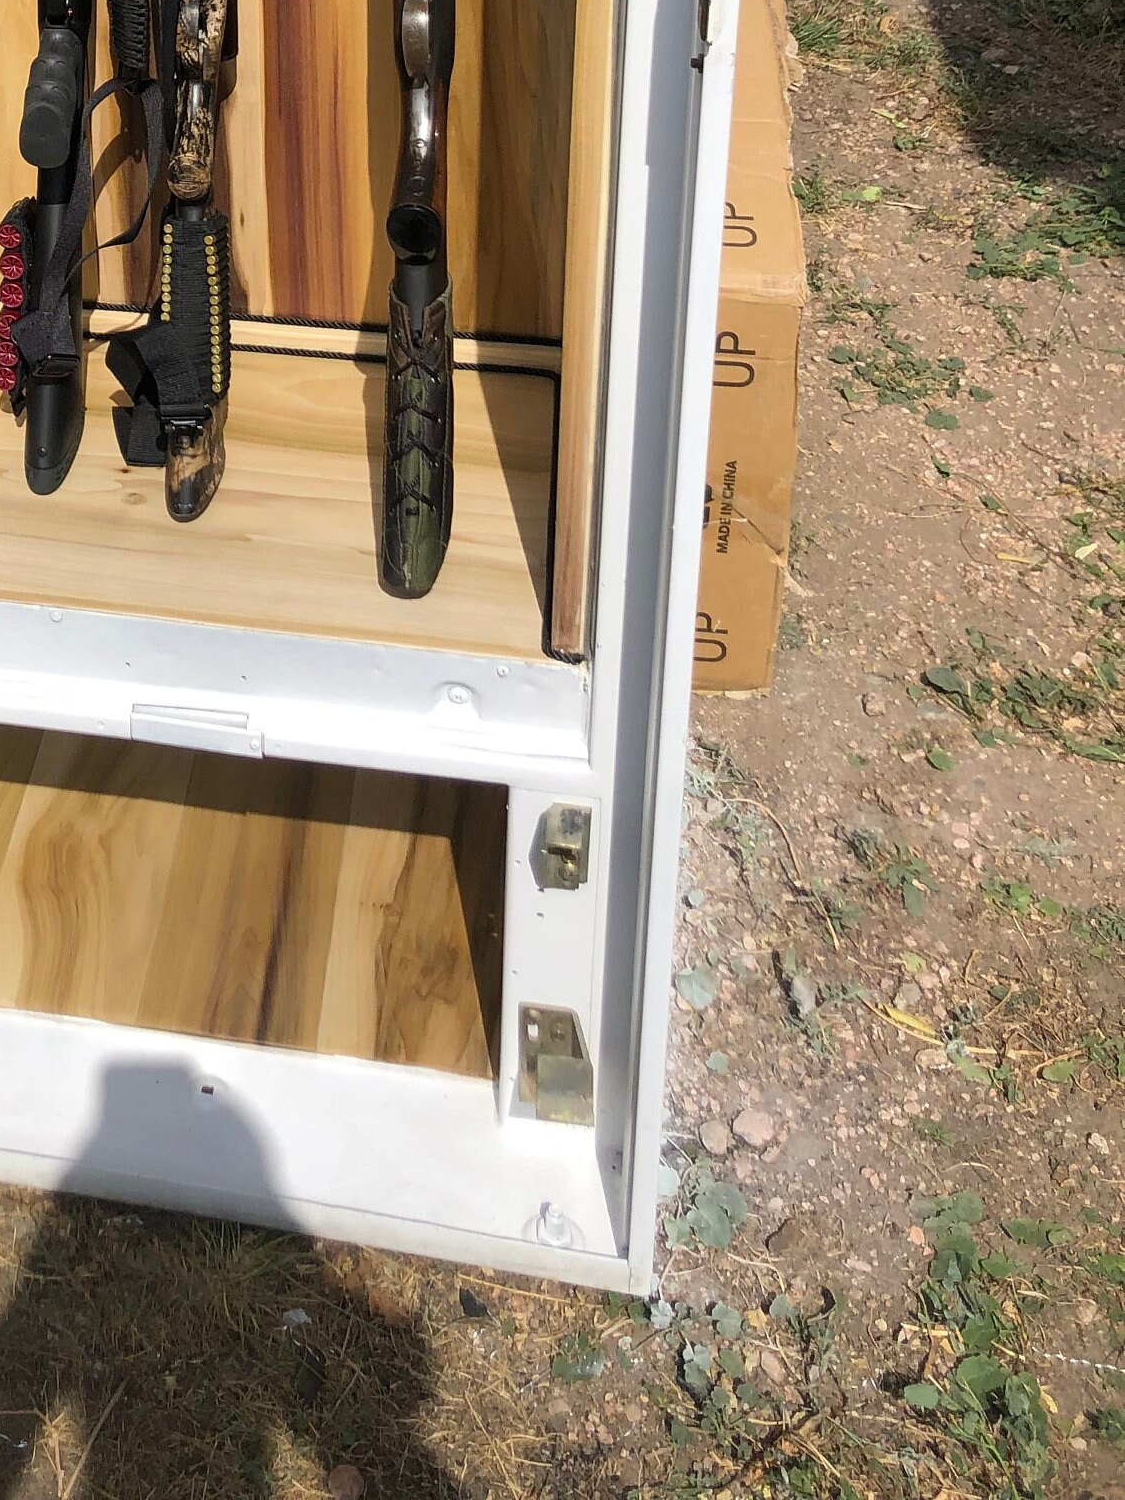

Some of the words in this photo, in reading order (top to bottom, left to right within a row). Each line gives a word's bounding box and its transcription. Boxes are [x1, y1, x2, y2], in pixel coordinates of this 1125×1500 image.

[722, 202, 757, 248] UP
[713, 331, 756, 388] UP
[722, 460, 737, 500] CHINA
[720, 502, 732, 516] IN
[716, 518, 731, 554] MADE
[694, 612, 728, 663] UP
